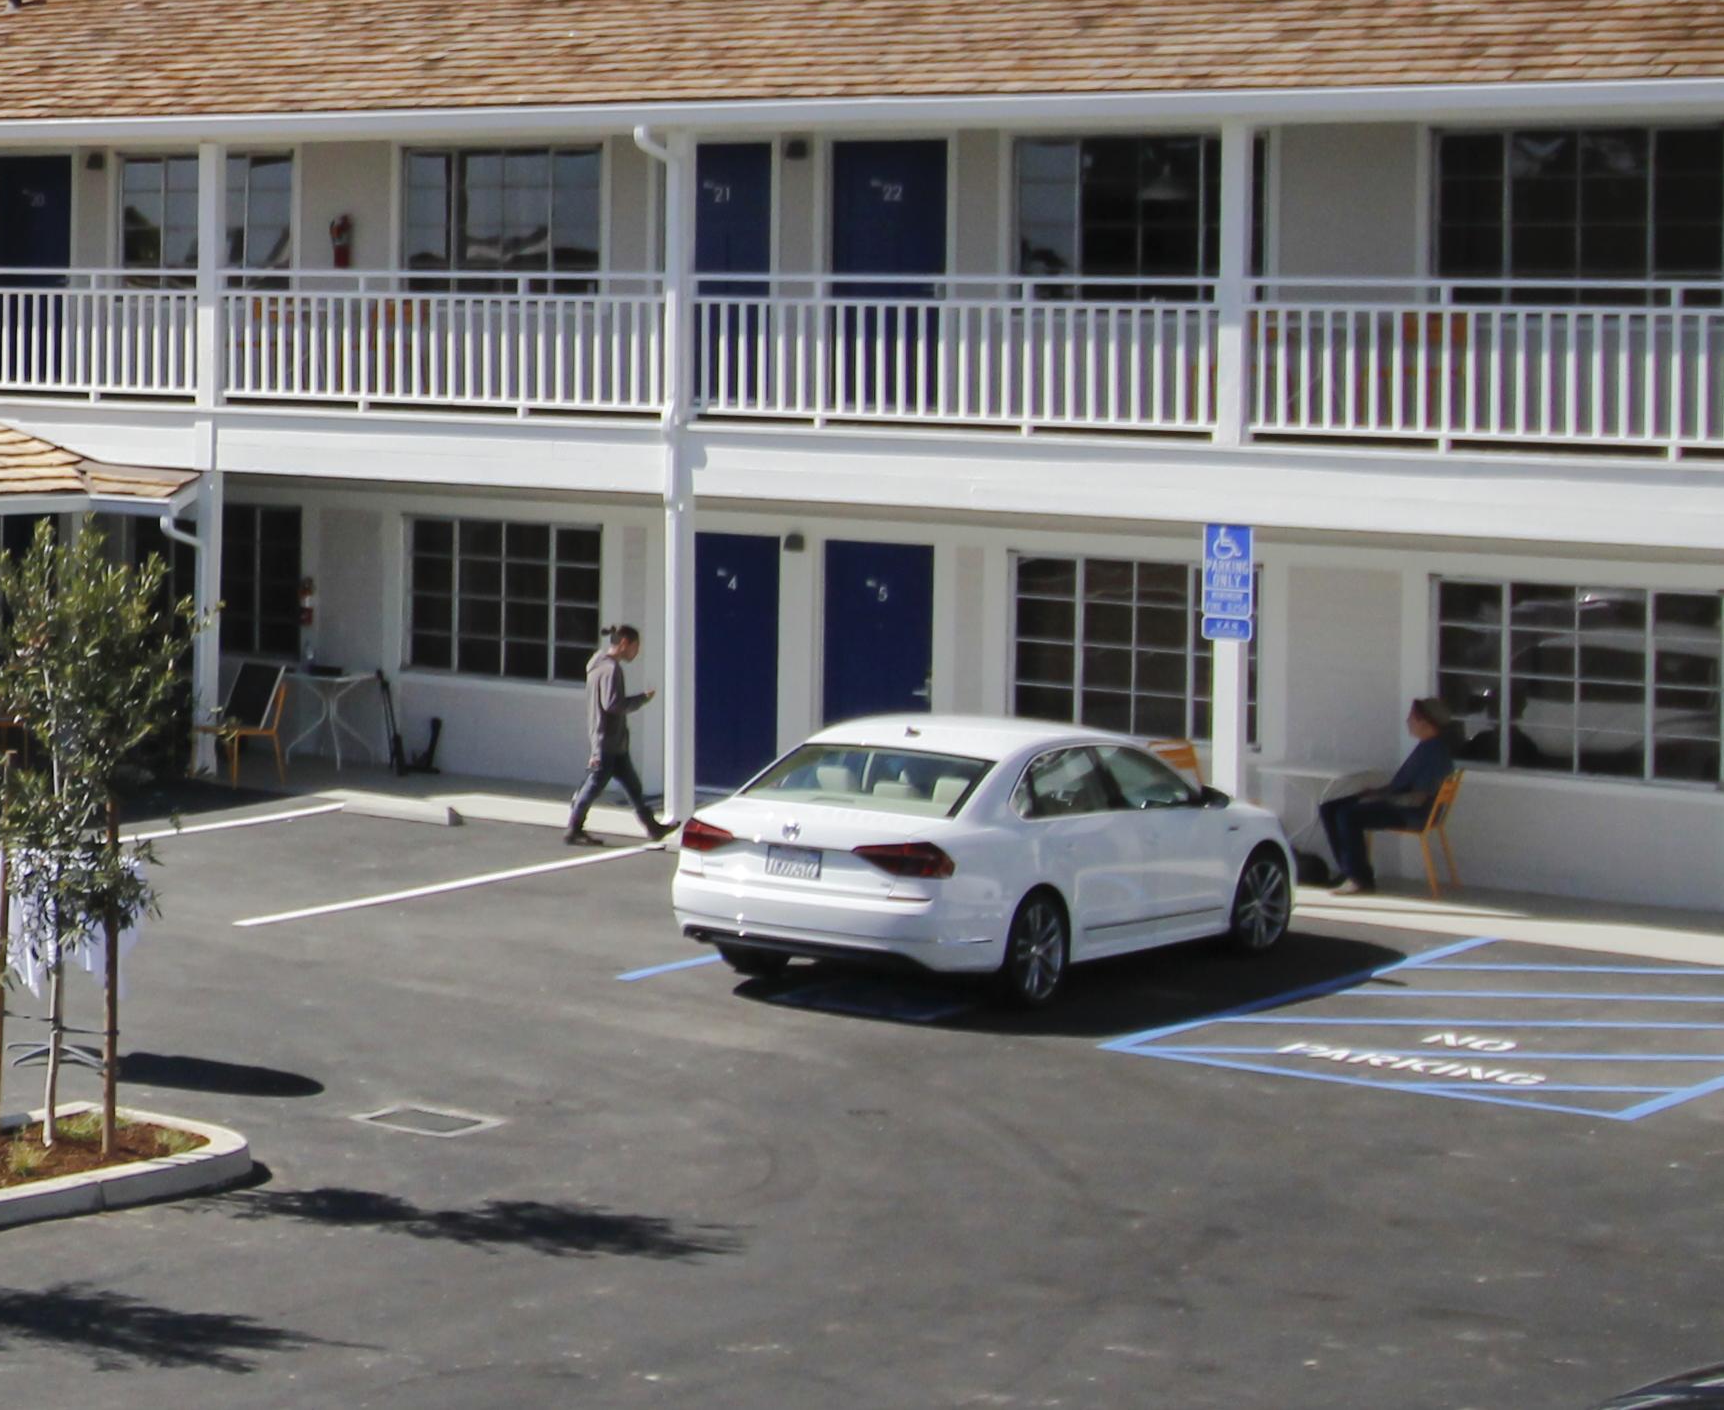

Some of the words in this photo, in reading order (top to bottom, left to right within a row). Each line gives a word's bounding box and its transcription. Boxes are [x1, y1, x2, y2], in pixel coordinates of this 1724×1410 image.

[714, 186, 730, 203] 21
[883, 184, 902, 202] 22
[1206, 558, 1249, 575] PARKING
[727, 575, 738, 591] 4
[1212, 573, 1241, 588] ONLY
[1216, 620, 1239, 631] VAN
[1421, 1032, 1516, 1052] NO
[1276, 1042, 1546, 1085] PARKING
